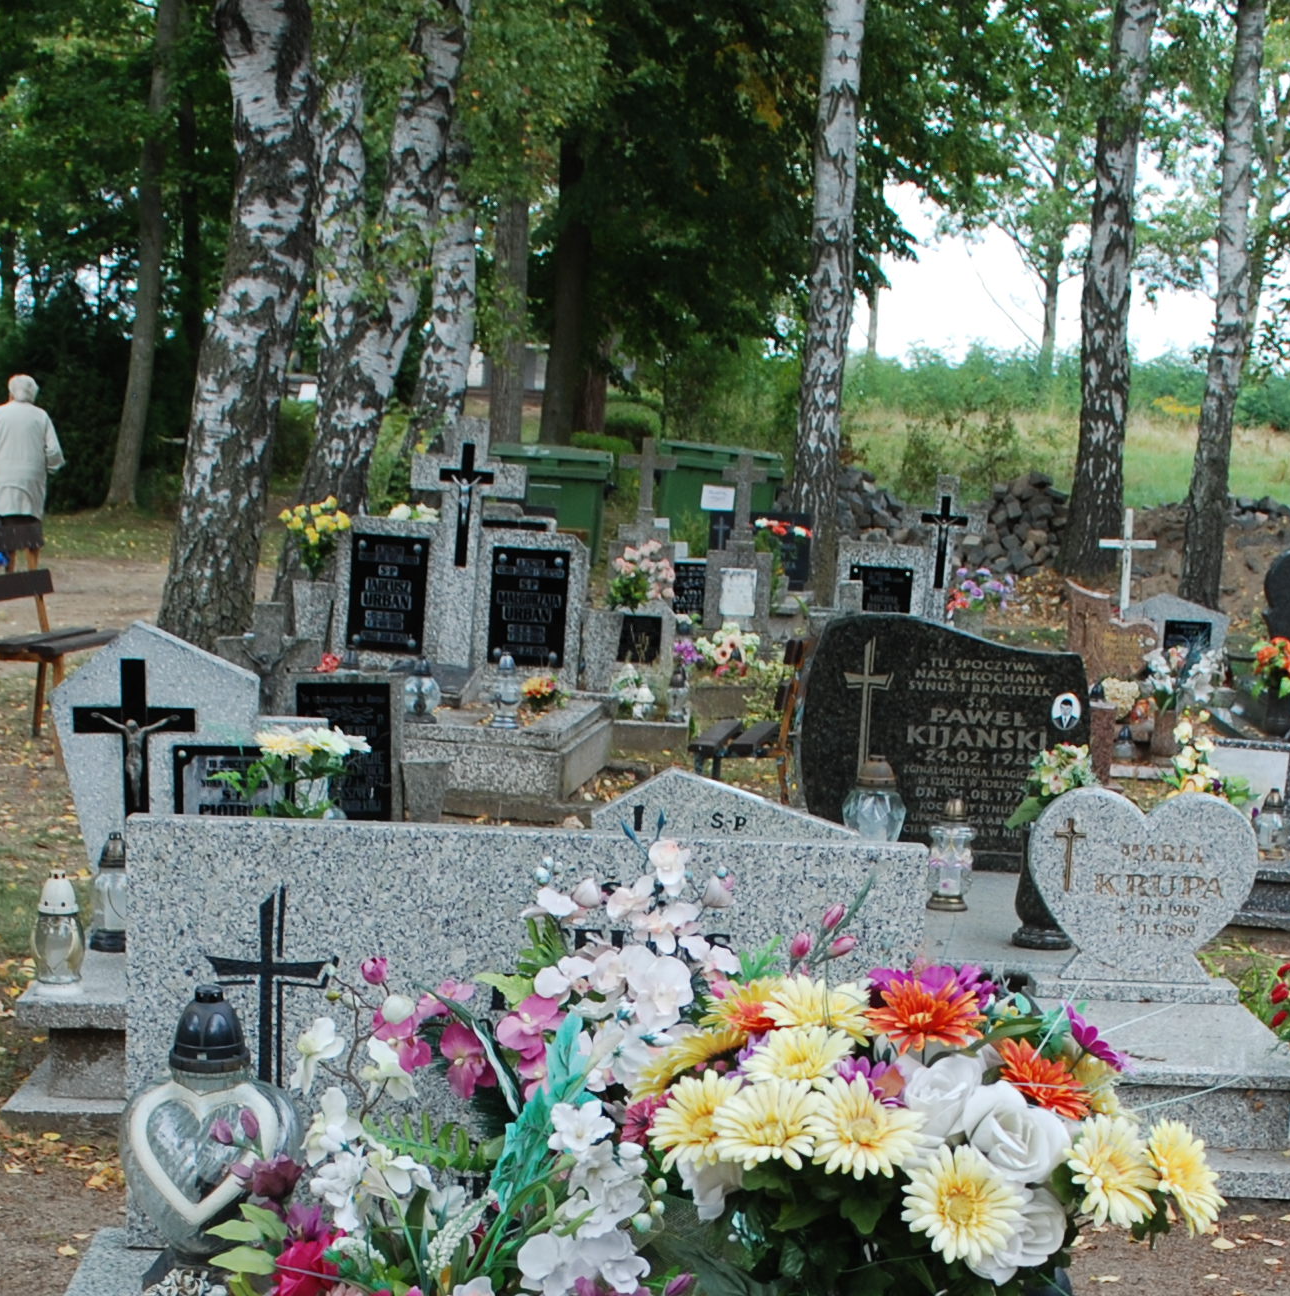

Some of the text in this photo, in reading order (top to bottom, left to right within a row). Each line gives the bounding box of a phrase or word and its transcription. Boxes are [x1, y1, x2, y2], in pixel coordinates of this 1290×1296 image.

[362, 593, 410, 609] URBAN
[503, 606, 551, 622] URBAN
[931, 658, 1035, 672] TU SPOCZYWA
[915, 669, 1046, 685] NASZ UKOCHANY
[971, 683, 1051, 697] BRACISZEK
[930, 707, 1028, 727] PAWEŁ
[1122, 843, 1203, 863] MARIA
[1093, 871, 1225, 899] KRUPA
